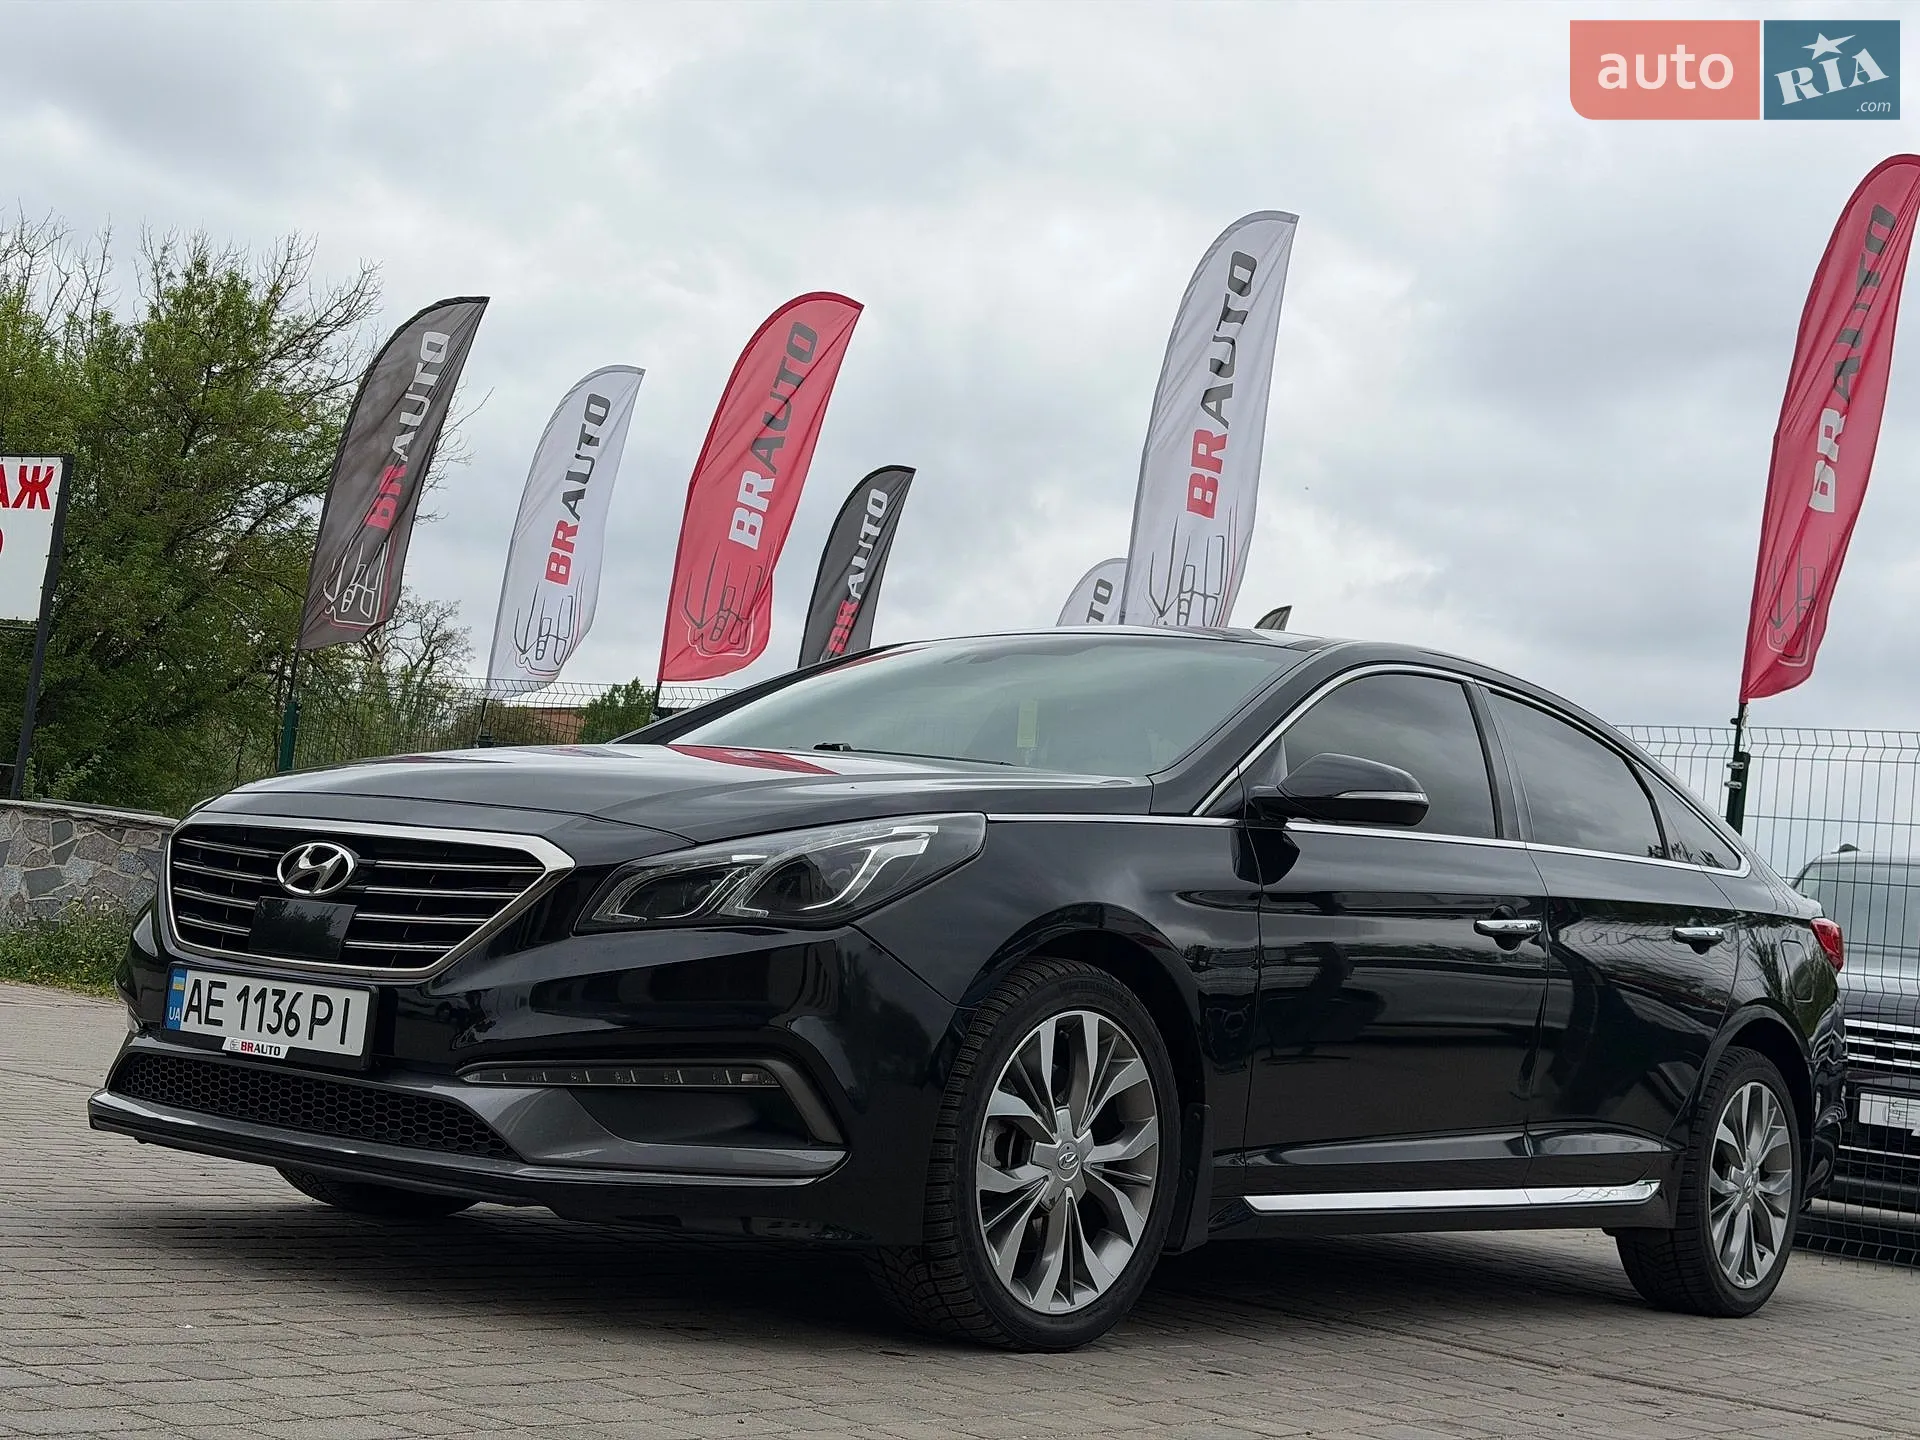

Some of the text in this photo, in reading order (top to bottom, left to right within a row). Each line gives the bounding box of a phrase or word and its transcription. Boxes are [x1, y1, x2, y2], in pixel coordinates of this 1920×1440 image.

[364, 331, 450, 531] BRAUTO
[728, 321, 819, 550] BRAUTO
[1186, 251, 1258, 519] BRAUTO
[545, 393, 611, 585] BRAUTO
[828, 489, 888, 655] BRAUTO
[169, 1006, 181, 1022] UA
[183, 978, 228, 1027] AE
[237, 985, 304, 1038] 1136
[240, 1040, 281, 1057] BRAUTO
